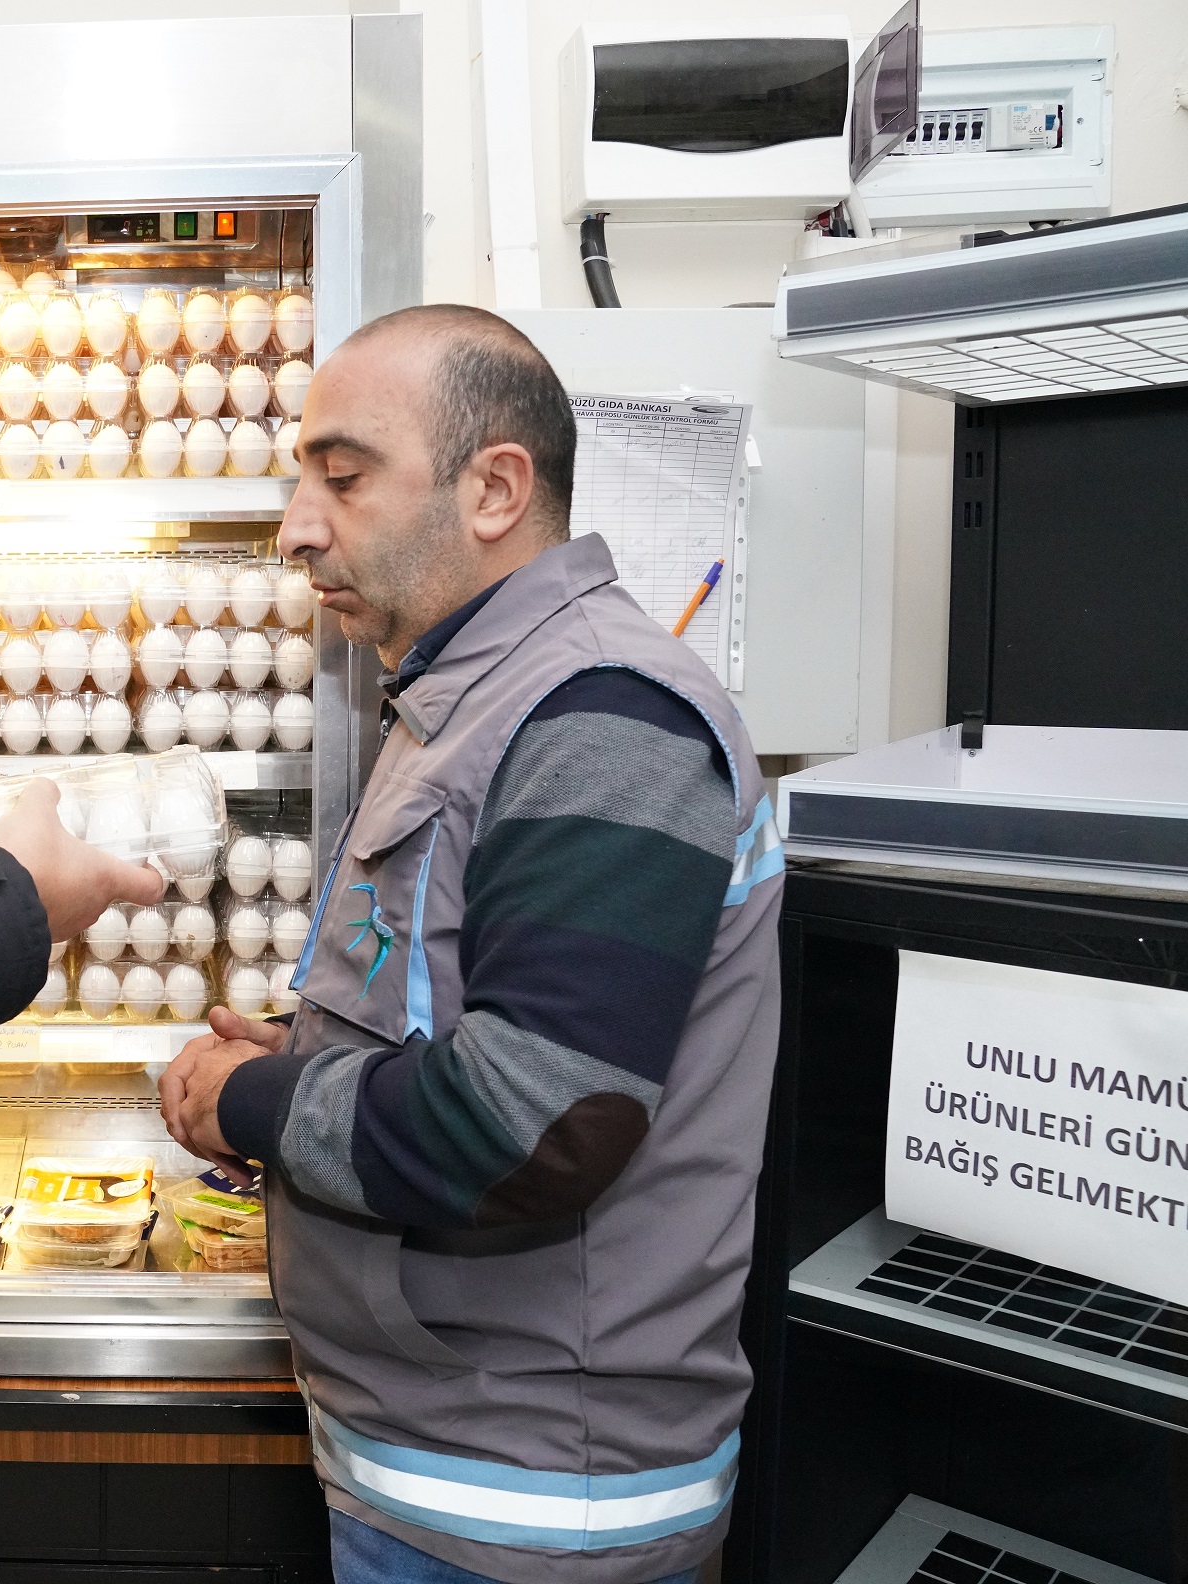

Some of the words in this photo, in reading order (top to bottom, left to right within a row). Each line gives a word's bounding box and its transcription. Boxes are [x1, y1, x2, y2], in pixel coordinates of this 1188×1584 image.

[596, 411, 622, 419] DEPOSU
[661, 416, 692, 424] KONTROL
[598, 400, 624, 409] GIDA
[626, 403, 672, 413] BANKASI
[966, 1041, 1057, 1083] UNLU
[924, 1081, 1093, 1148] ÜRÜNLERİ
[904, 1135, 999, 1187] BAĞIŞ
[1010, 1162, 1188, 1231] GELMEKT
